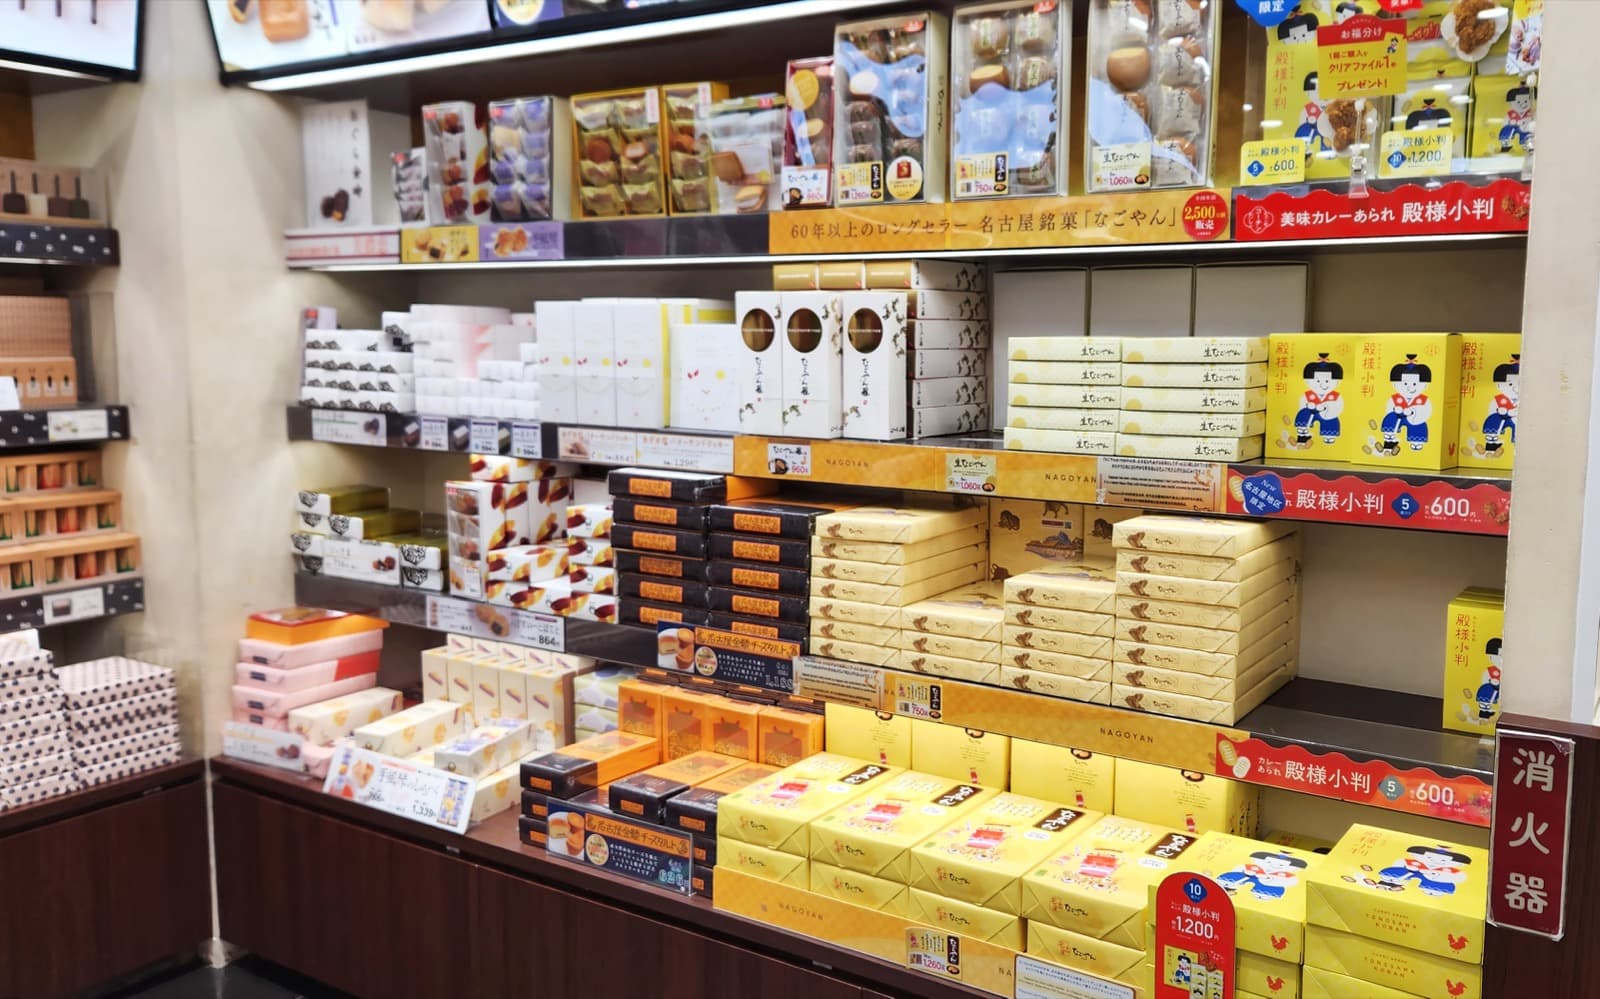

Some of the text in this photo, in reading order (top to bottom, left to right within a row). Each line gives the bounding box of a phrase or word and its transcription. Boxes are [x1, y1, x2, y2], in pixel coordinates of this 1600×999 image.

[1340, 26, 1382, 42] お福分け
[790, 207, 1177, 242] 60年以上のロングセラー 名古屋銘菓「なごやん」
[1280, 197, 1495, 229] 美味カレーあられ 殿様小判
[1274, 342, 1289, 395] 殿様小判
[1361, 342, 1376, 398] 殿様小判
[1460, 342, 1478, 399] 殿様小判
[1044, 473, 1097, 487] NAGOYAN
[1295, 488, 1384, 516] 殿様小判
[1454, 613, 1470, 667] 殿様小判
[1098, 726, 1154, 744] NAGOYAN
[1257, 757, 1282, 770] カレー
[1257, 770, 1282, 782] あられ
[1284, 759, 1371, 800] 殿様小判
[1503, 747, 1556, 915] 消火器
[1189, 883, 1202, 896] 10
[1182, 904, 1220, 922] 殿様小判
